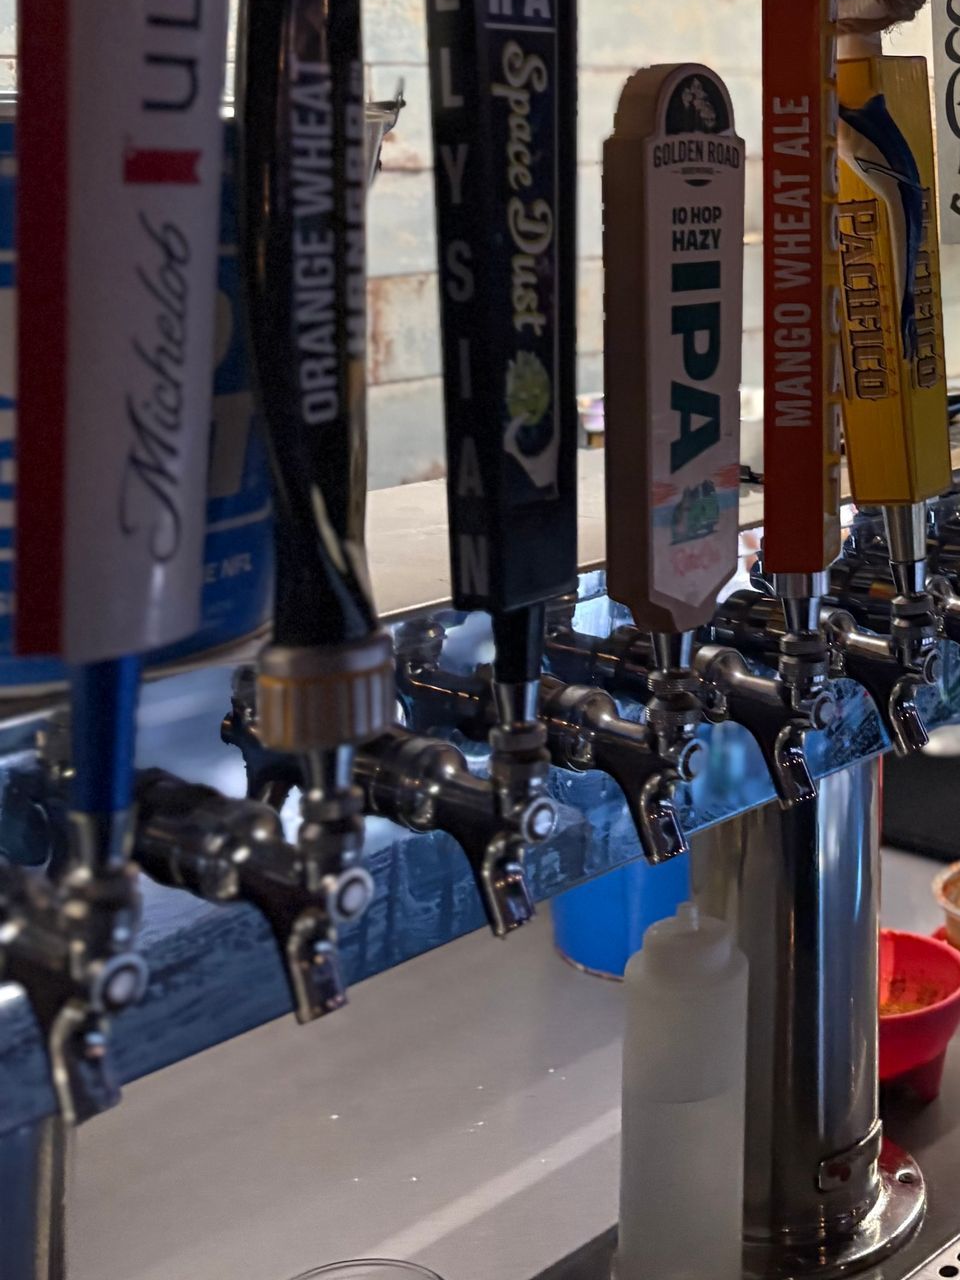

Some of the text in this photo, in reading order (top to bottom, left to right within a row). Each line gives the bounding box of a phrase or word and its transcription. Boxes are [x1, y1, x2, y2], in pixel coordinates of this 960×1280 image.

[491, 40, 563, 336] Space Dust
[653, 140, 740, 169] GOLDEN ROAD
[672, 229, 721, 252] HAZY
[691, 206, 722, 224] HOP
[294, 231, 338, 425] ORANGE
[772, 94, 811, 428] MANGO WHEAT ALE
[838, 197, 889, 401] PACIFICO
[119, 210, 191, 564] Michelob
[670, 261, 721, 475] IPA
